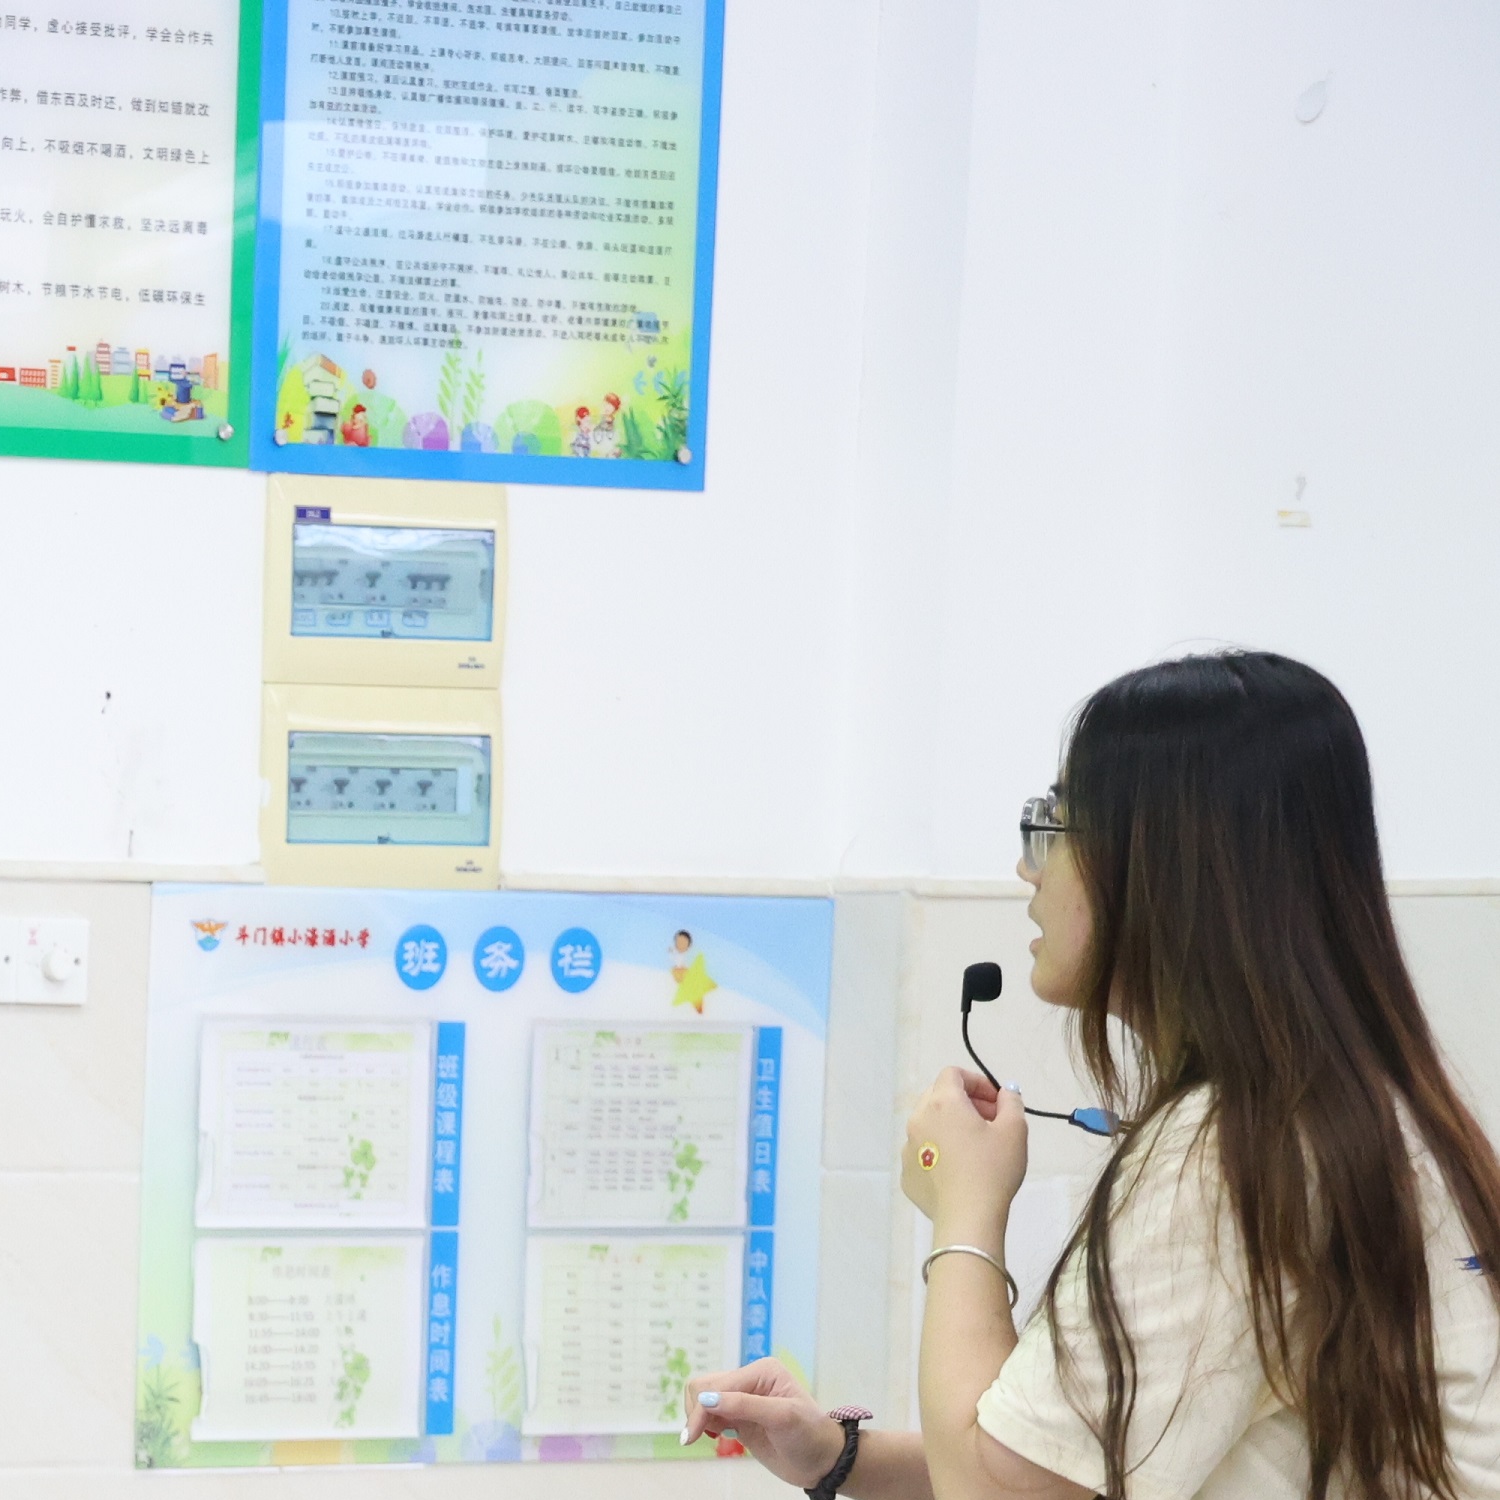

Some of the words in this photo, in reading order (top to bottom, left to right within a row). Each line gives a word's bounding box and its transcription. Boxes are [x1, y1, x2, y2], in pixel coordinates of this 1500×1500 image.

[401, 939, 596, 980] 班务栏
[434, 1053, 460, 1195] 班级课程表
[751, 1056, 778, 1195] 卫生值日表
[430, 1264, 452, 1403] 作息时间表
